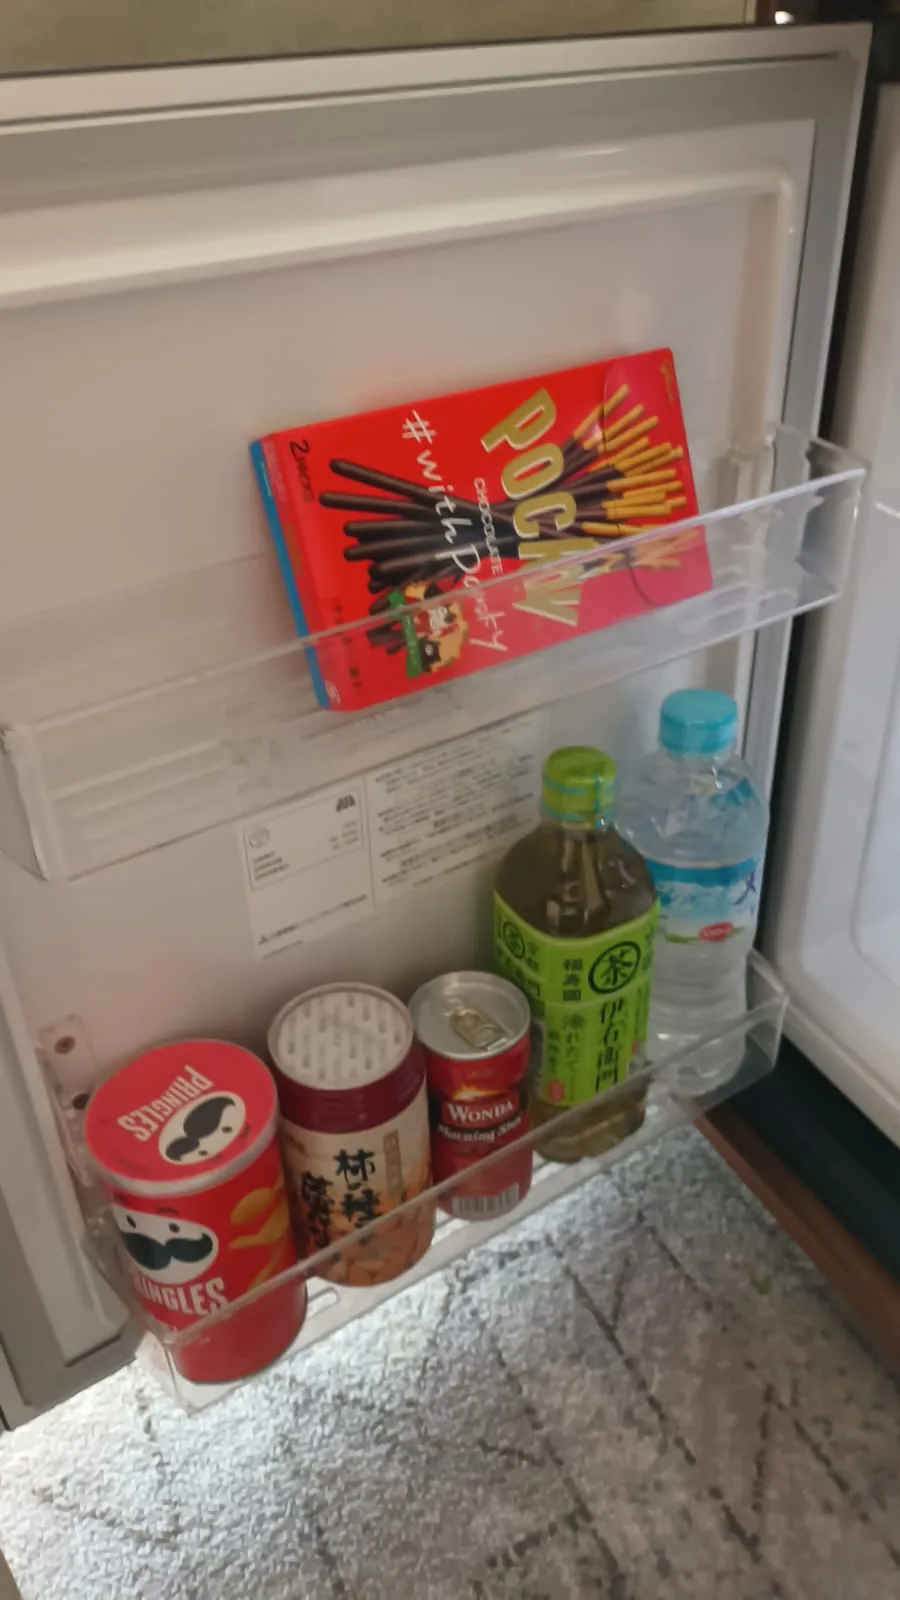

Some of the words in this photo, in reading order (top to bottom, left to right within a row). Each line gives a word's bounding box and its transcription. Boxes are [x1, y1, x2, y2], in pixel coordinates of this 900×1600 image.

[473, 476, 503, 576] CHOCOLATE
[480, 388, 600, 627] POCKY
[593, 944, 638, 991] 茶
[117, 1064, 214, 1142] PRINGLES
[446, 1100, 514, 1123] WONDA
